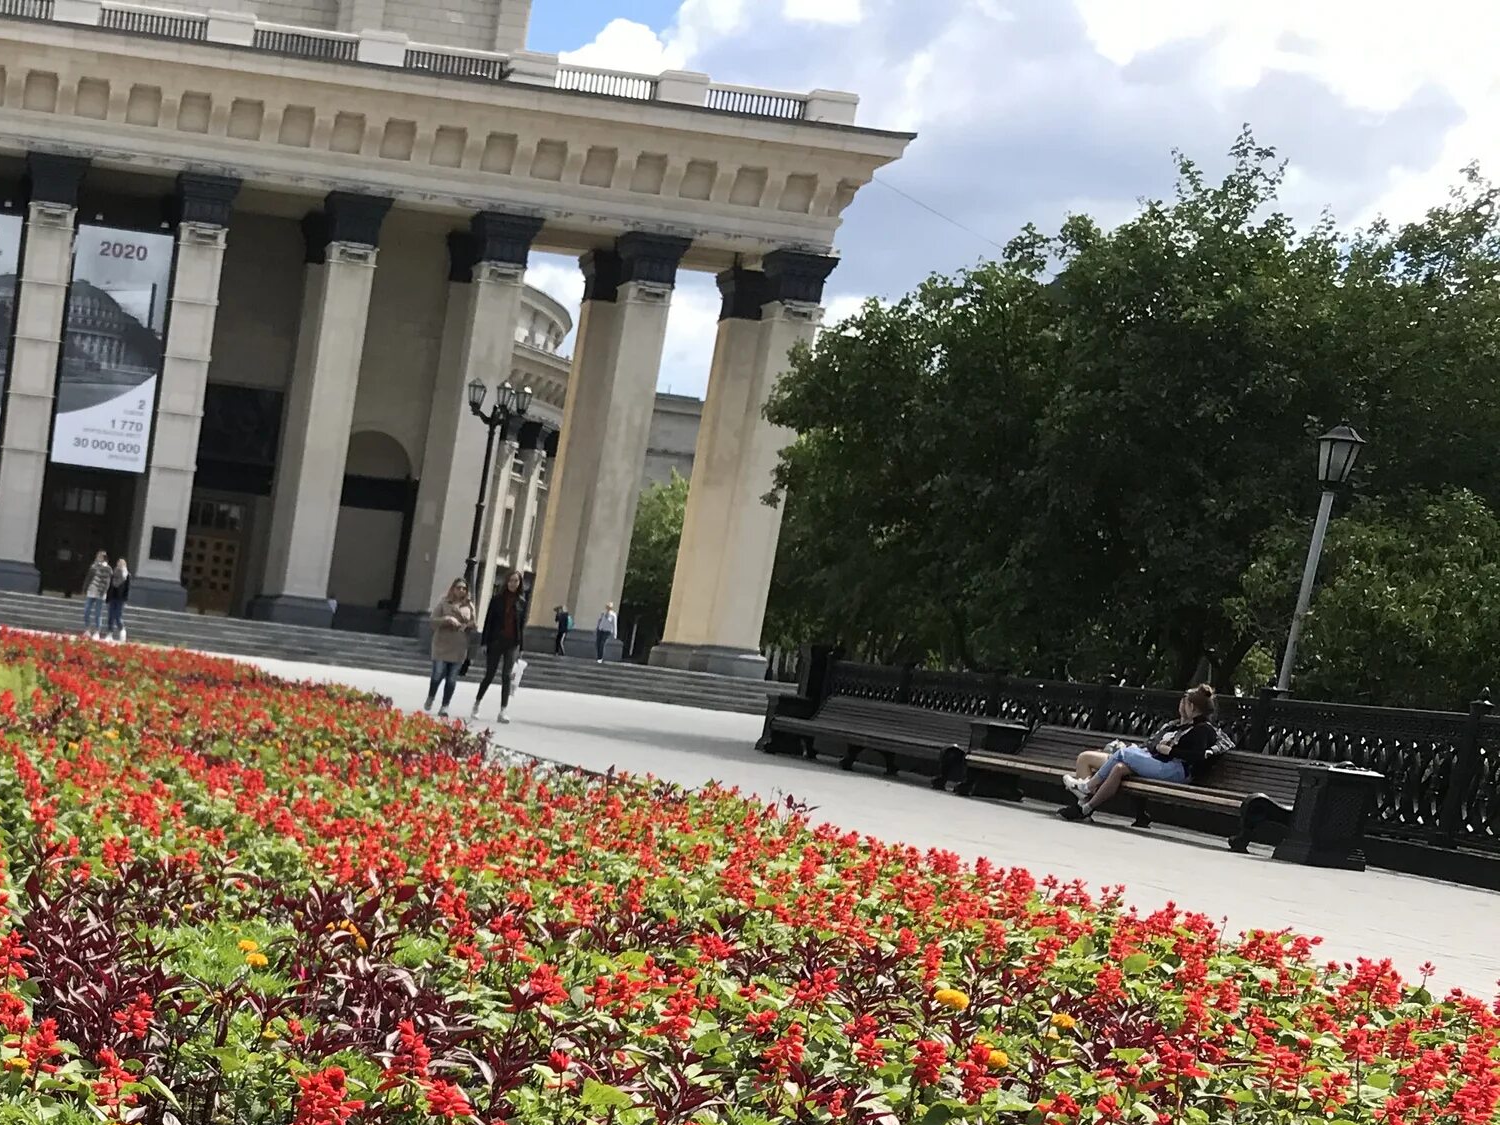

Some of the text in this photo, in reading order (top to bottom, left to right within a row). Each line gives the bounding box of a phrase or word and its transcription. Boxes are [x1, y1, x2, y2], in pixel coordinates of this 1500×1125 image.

[99, 241, 148, 261] 2020
[138, 400, 146, 410] 2
[111, 419, 144, 432] 1 770
[73, 437, 141, 455] 30 000 000
